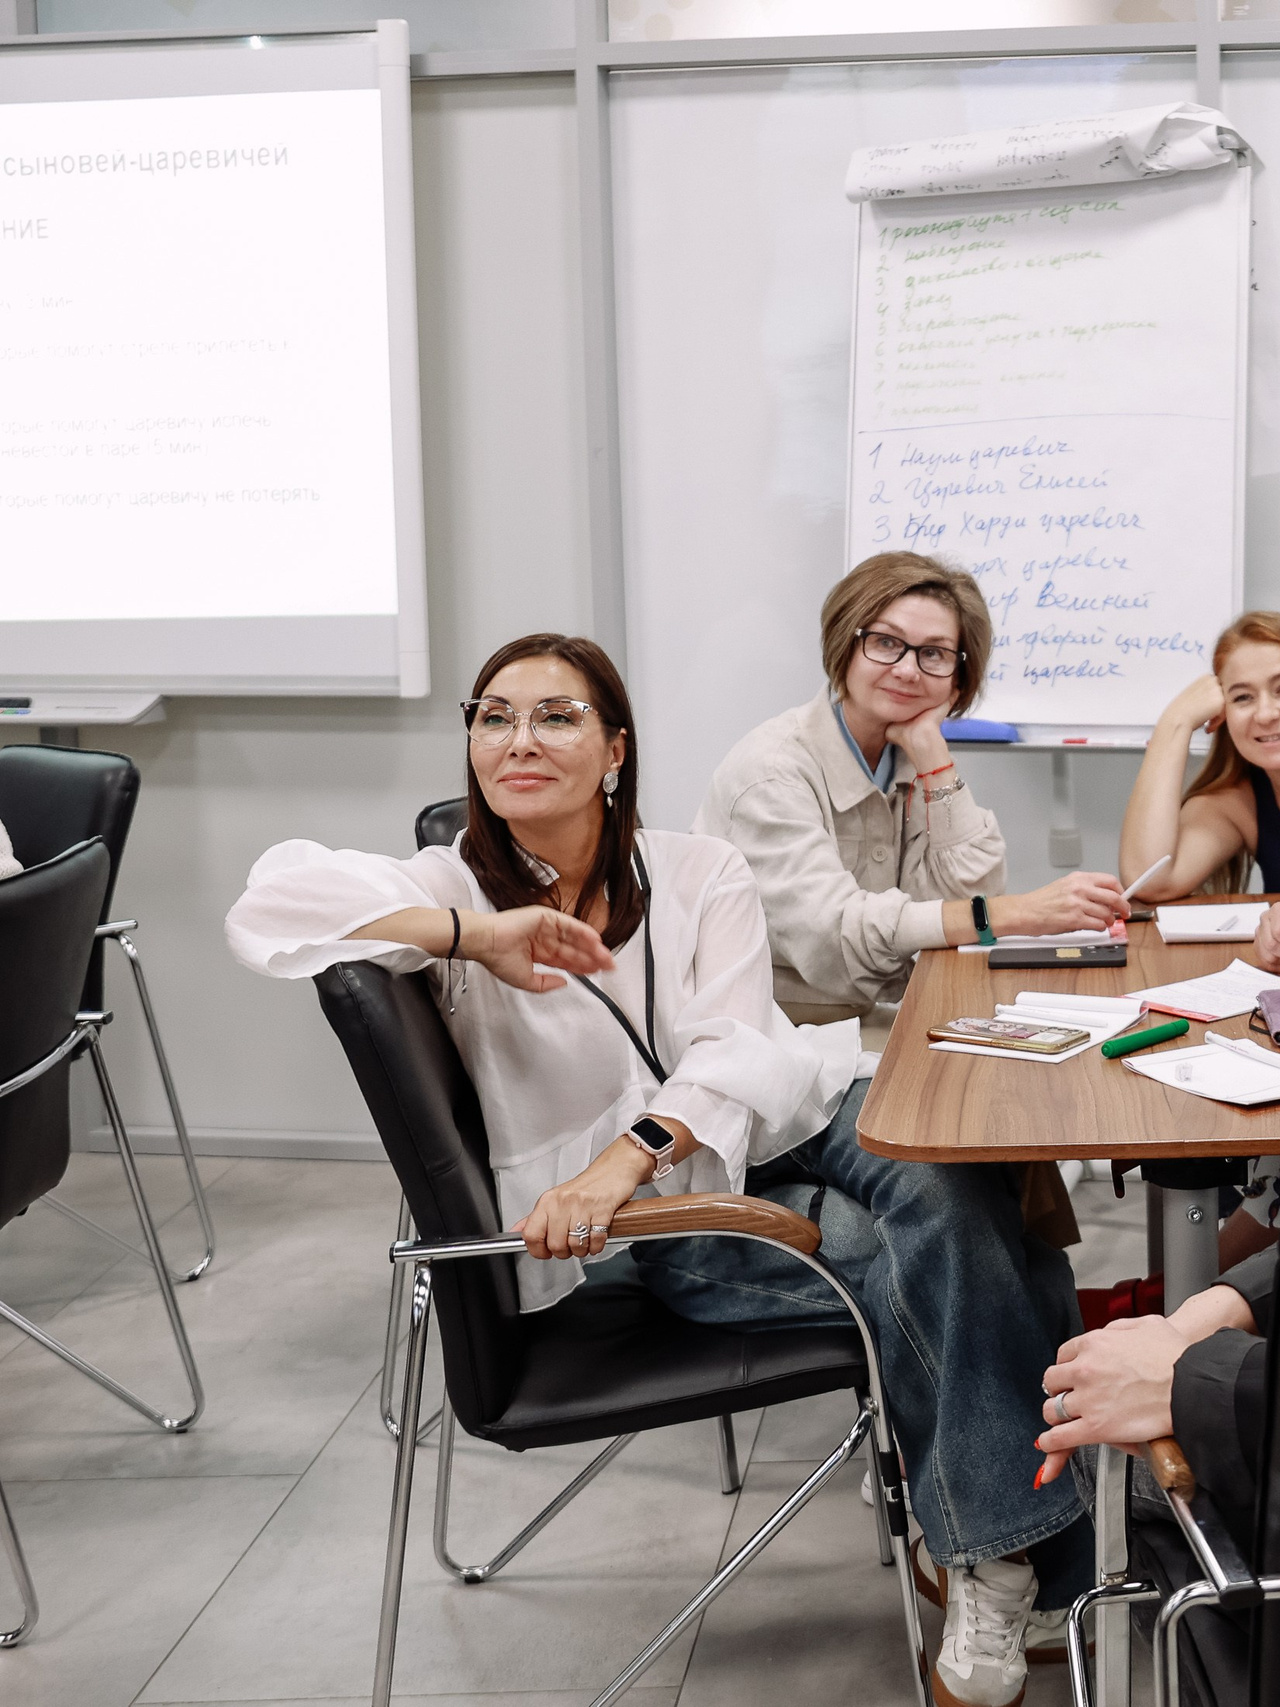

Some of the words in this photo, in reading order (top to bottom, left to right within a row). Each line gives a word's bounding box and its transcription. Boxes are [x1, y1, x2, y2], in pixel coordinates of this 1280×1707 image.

[2, 142, 290, 177] сыновей-царевичей
[2, 218, 49, 241] НИЕ
[214, 487, 236, 503] не
[240, 486, 322, 505] потерять
[869, 479, 893, 505] 2
[872, 515, 892, 543] 3
